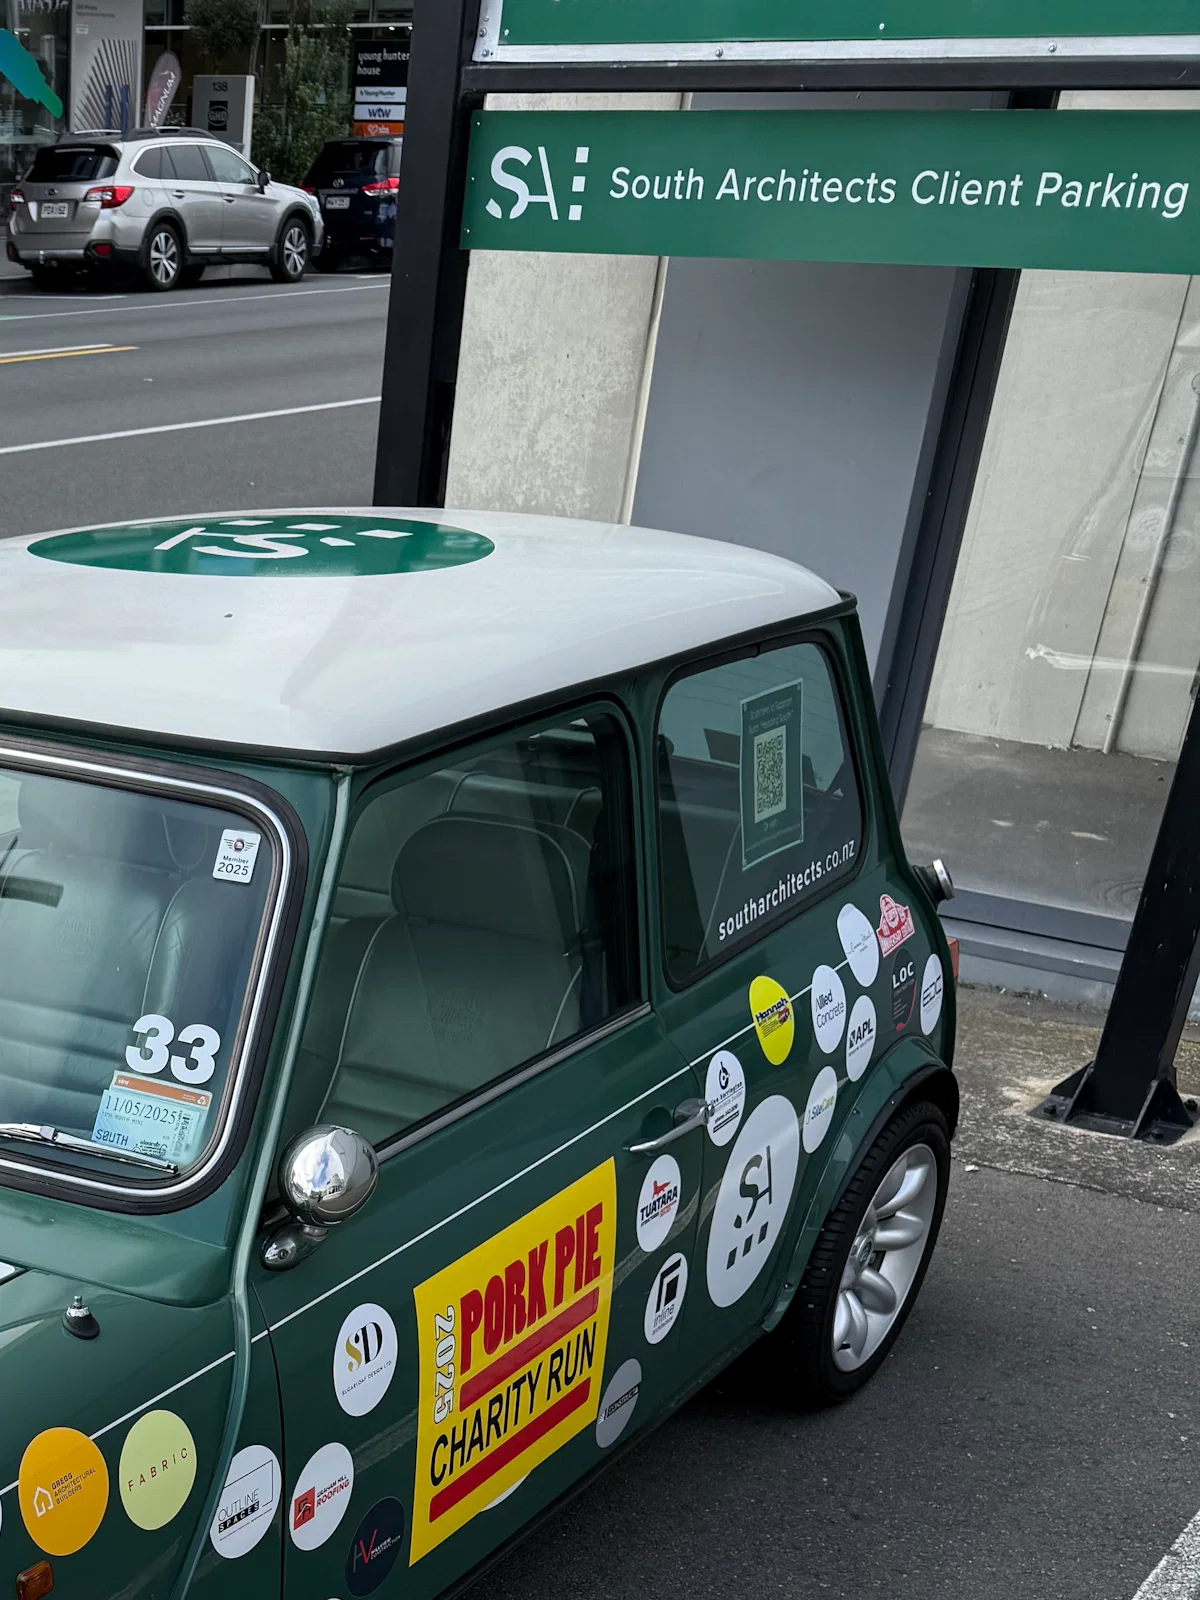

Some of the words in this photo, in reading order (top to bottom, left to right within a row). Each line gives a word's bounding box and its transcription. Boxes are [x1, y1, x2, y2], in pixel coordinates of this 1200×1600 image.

[357, 65, 381, 75] house
[358, 52, 382, 65] young
[383, 48, 410, 60] hunter
[609, 166, 704, 202] South
[716, 168, 896, 205] Architects
[911, 170, 1022, 206] Client
[1036, 173, 1190, 219] Parking
[217, 862, 249, 876] 2025
[223, 855, 249, 864] Member
[719, 840, 855, 941] southarchitects.co.nz
[893, 961, 914, 989] LOC
[755, 997, 788, 1022] Hannah
[816, 1001, 844, 1028] Concrete
[855, 1018, 874, 1045] APL
[125, 1013, 221, 1085] 33
[105, 1095, 177, 1125] 11/05/2025
[640, 1185, 678, 1221] TUATARA
[460, 1239, 547, 1376] PORK
[554, 1202, 604, 1295] PIE
[433, 1304, 455, 1425] 2025
[430, 1366, 543, 1488] CHARITY
[548, 1321, 596, 1401] RUN
[51, 1472, 73, 1489] GREGG
[54, 1467, 96, 1497] ARCHITECTURAL
[128, 1448, 188, 1492] FABRIC
[56, 1485, 82, 1505] BUILDERS
[219, 1488, 259, 1521] OUTLINE
[317, 1479, 350, 1507] ROOFING
[219, 1501, 259, 1533] SPACES
